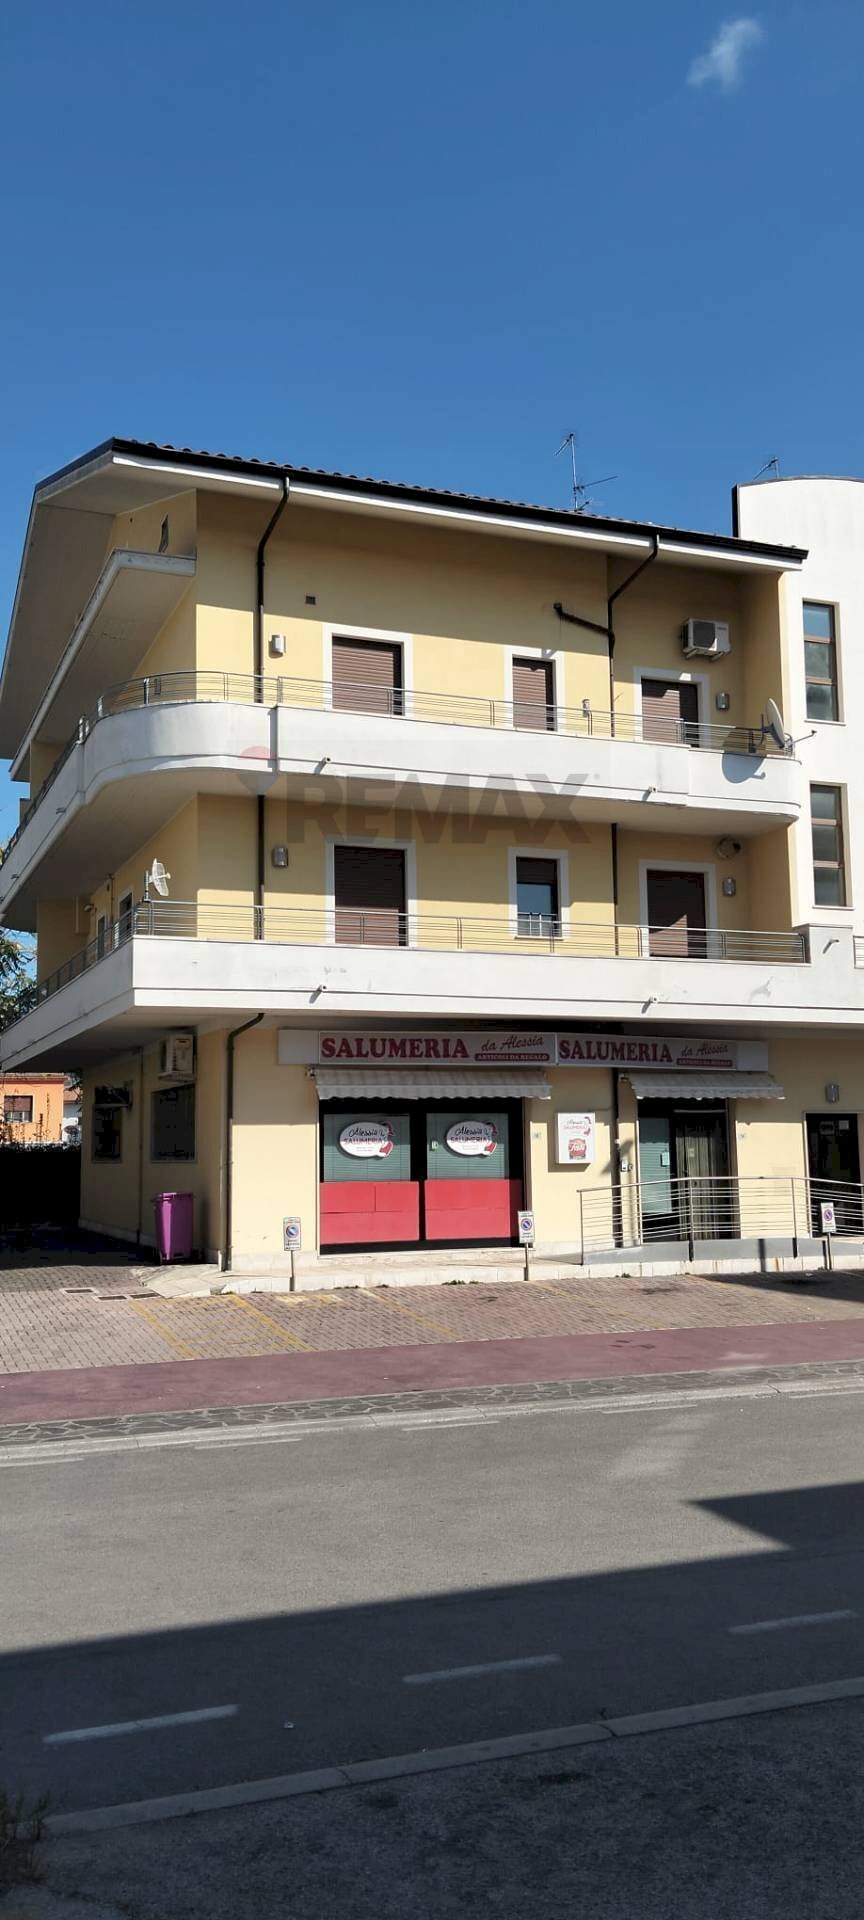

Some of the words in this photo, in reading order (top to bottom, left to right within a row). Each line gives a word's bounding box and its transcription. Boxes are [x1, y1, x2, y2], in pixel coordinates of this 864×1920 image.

[321, 1037, 470, 1059] SALUMERIA
[481, 1039, 497, 1051] da
[499, 1034, 545, 1050] Alessia
[559, 1040, 673, 1063] SALUMERIA
[344, 1137, 383, 1145] SALUMERIA
